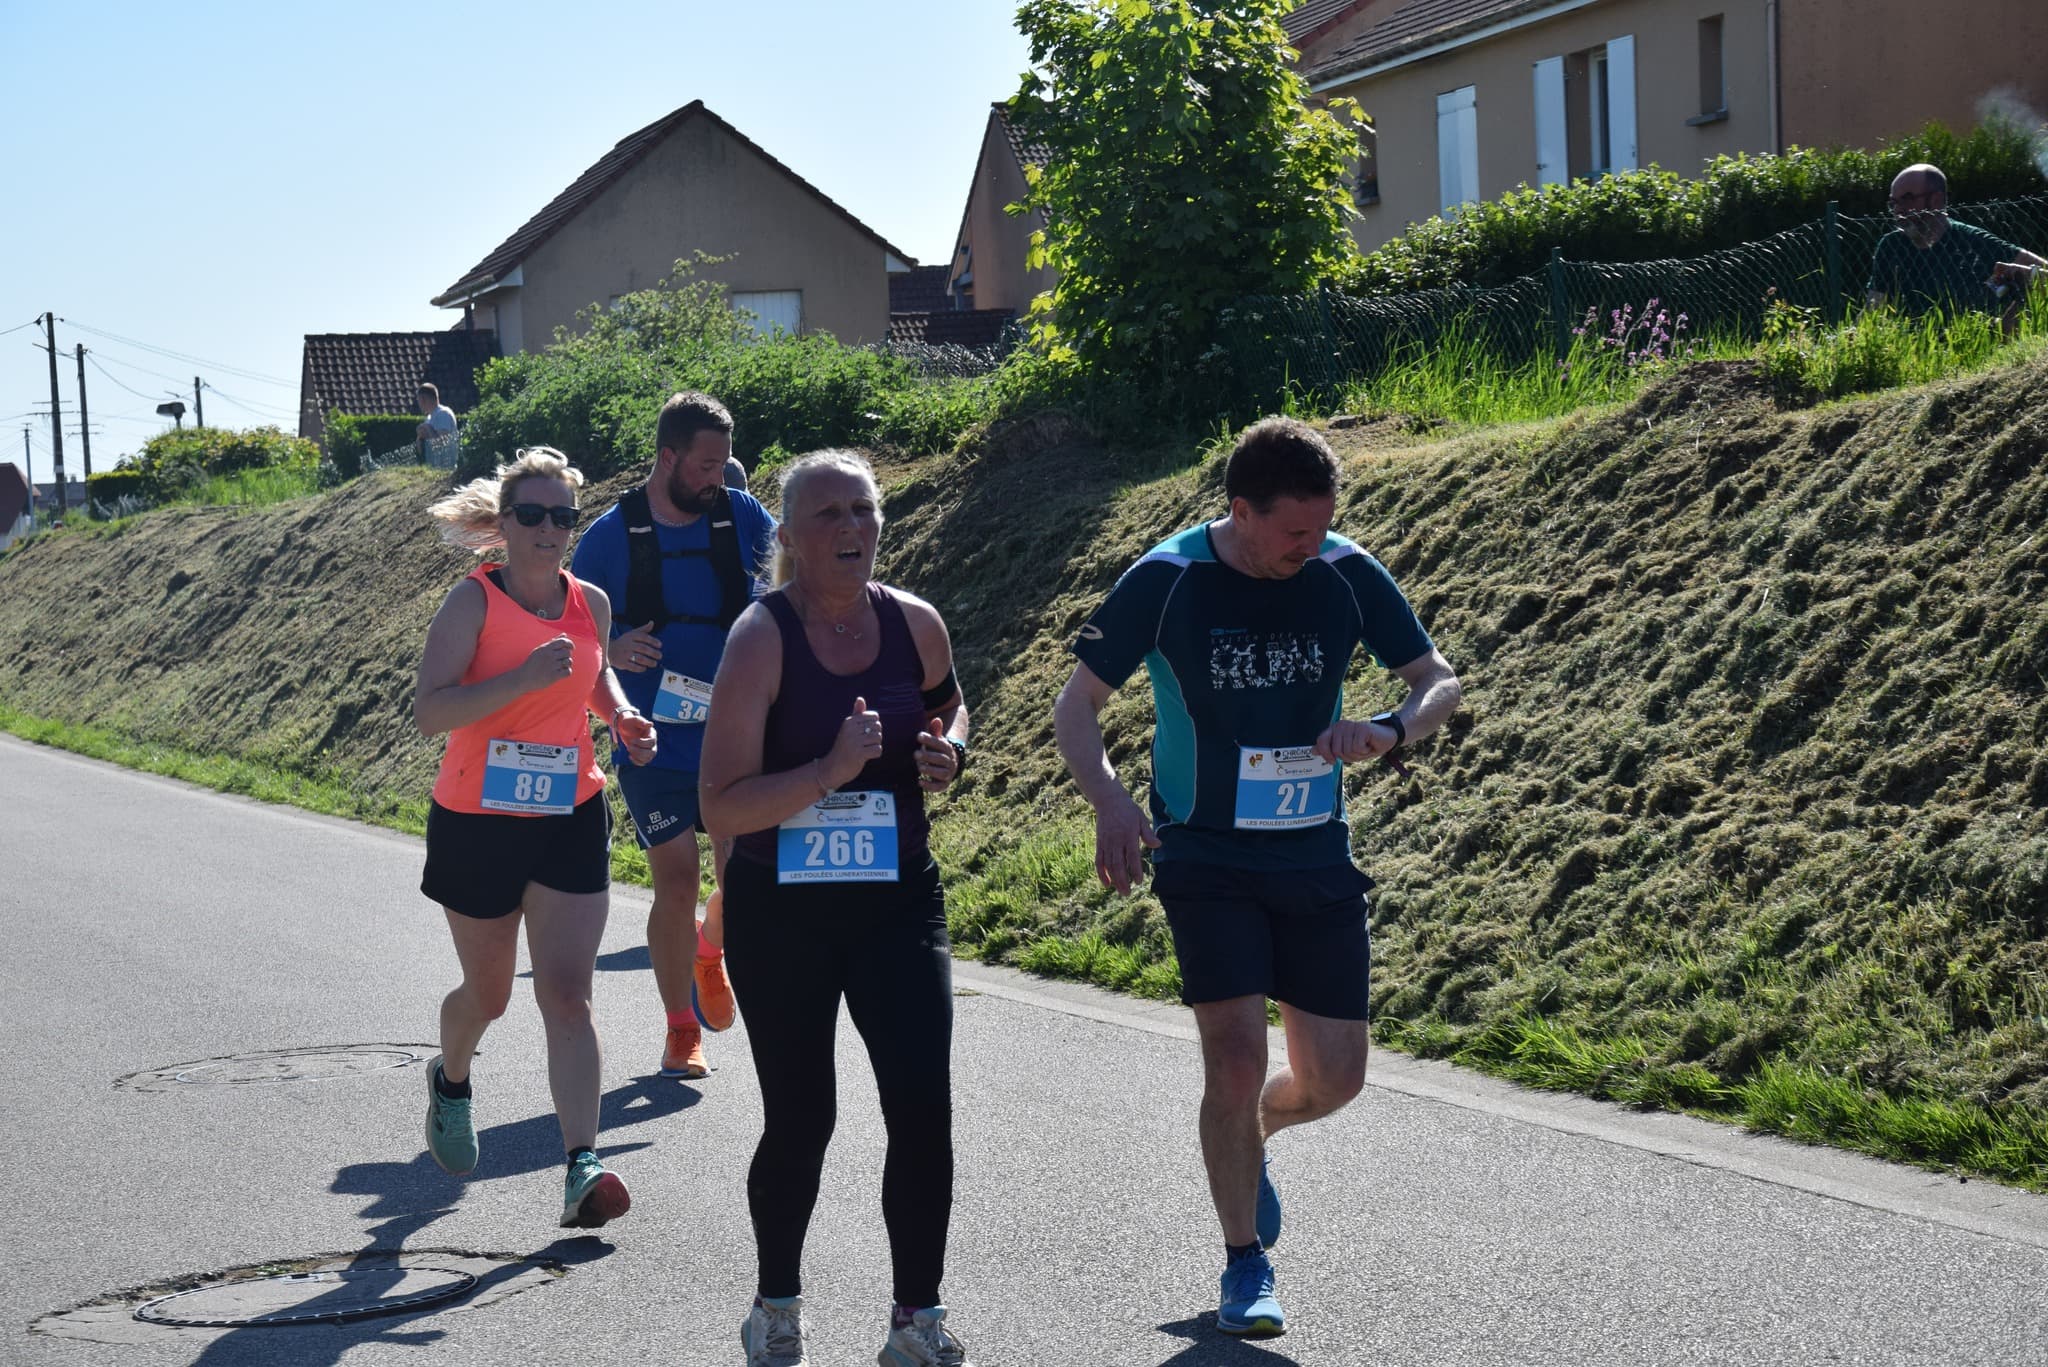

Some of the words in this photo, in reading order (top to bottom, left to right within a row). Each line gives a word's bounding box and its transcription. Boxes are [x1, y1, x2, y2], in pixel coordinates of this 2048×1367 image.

[678, 699, 707, 721] 34
[514, 773, 552, 803] 89
[1276, 781, 1310, 816] 27
[804, 830, 874, 867] 266
[804, 871, 834, 879] POULÉES
